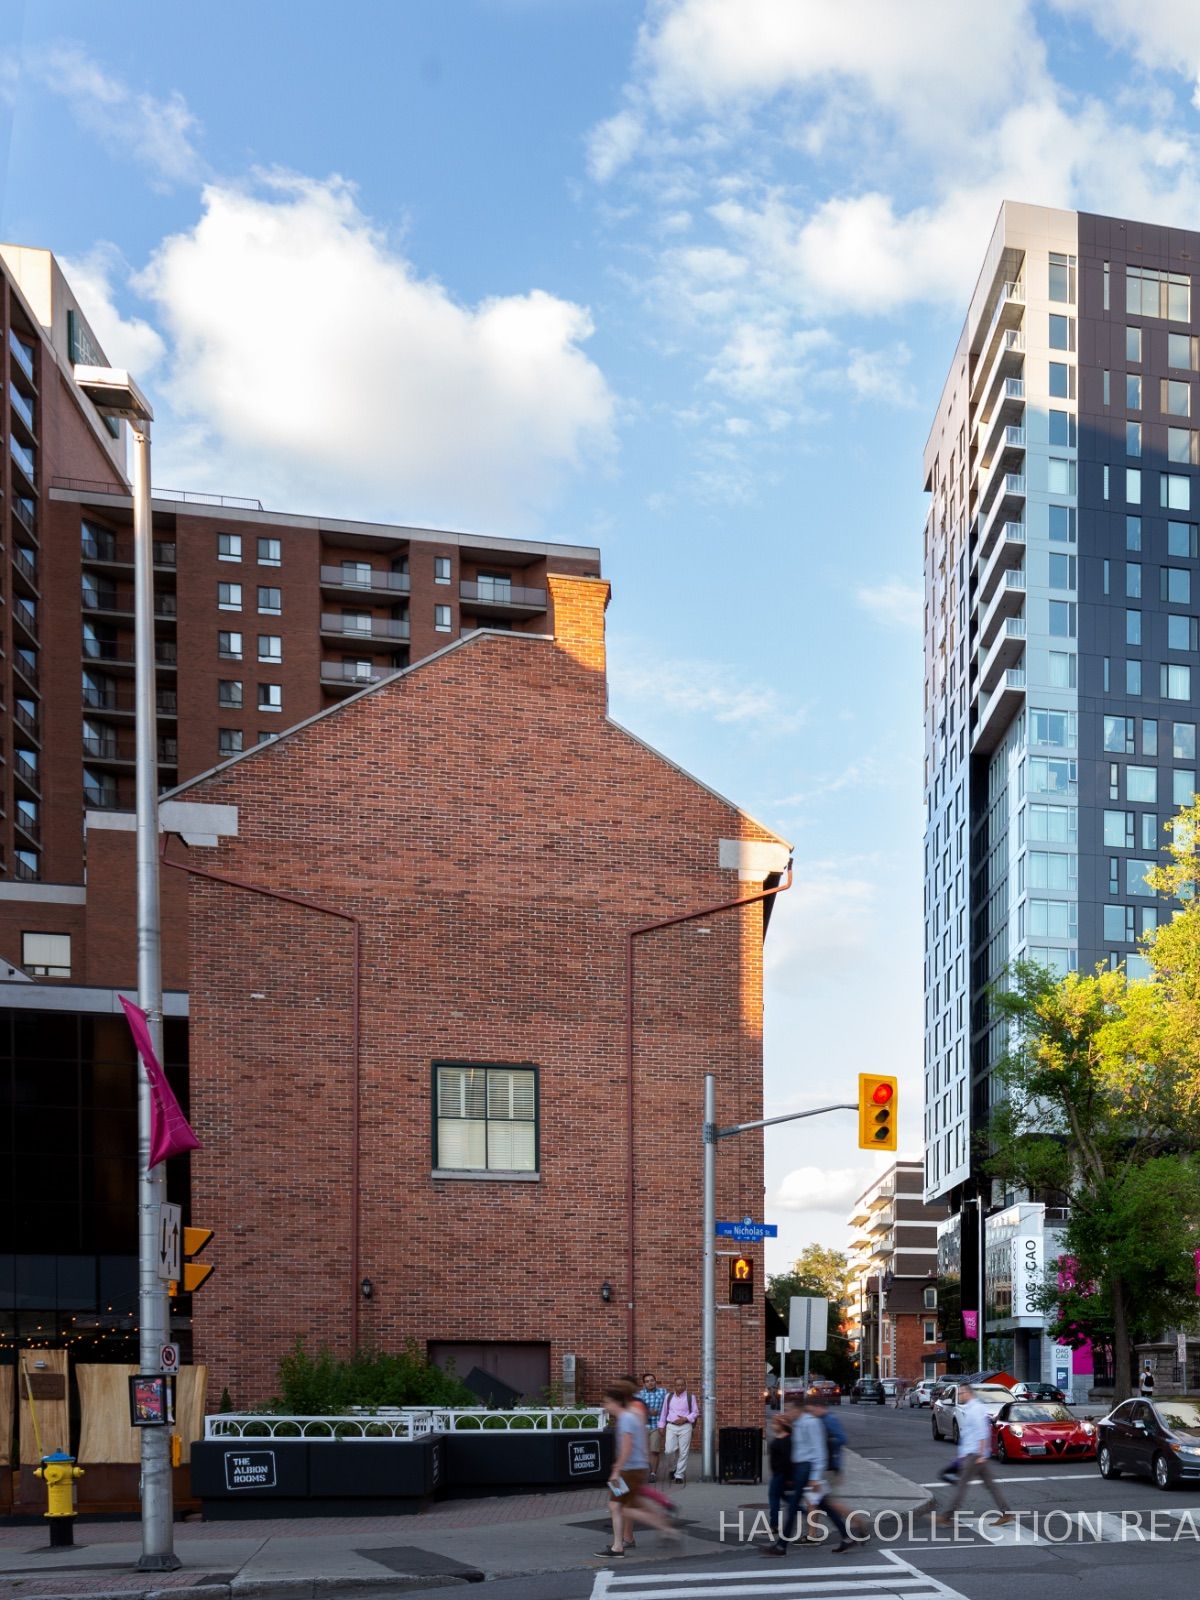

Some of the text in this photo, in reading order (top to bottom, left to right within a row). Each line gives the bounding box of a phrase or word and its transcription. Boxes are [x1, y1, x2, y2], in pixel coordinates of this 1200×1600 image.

[734, 1225, 764, 1236] Nicholas
[1025, 1240, 1036, 1271] GAO
[573, 1446, 585, 1454] THE
[232, 1457, 251, 1466] THE
[233, 1465, 269, 1475] ALBION
[233, 1474, 267, 1483] ROOMS
